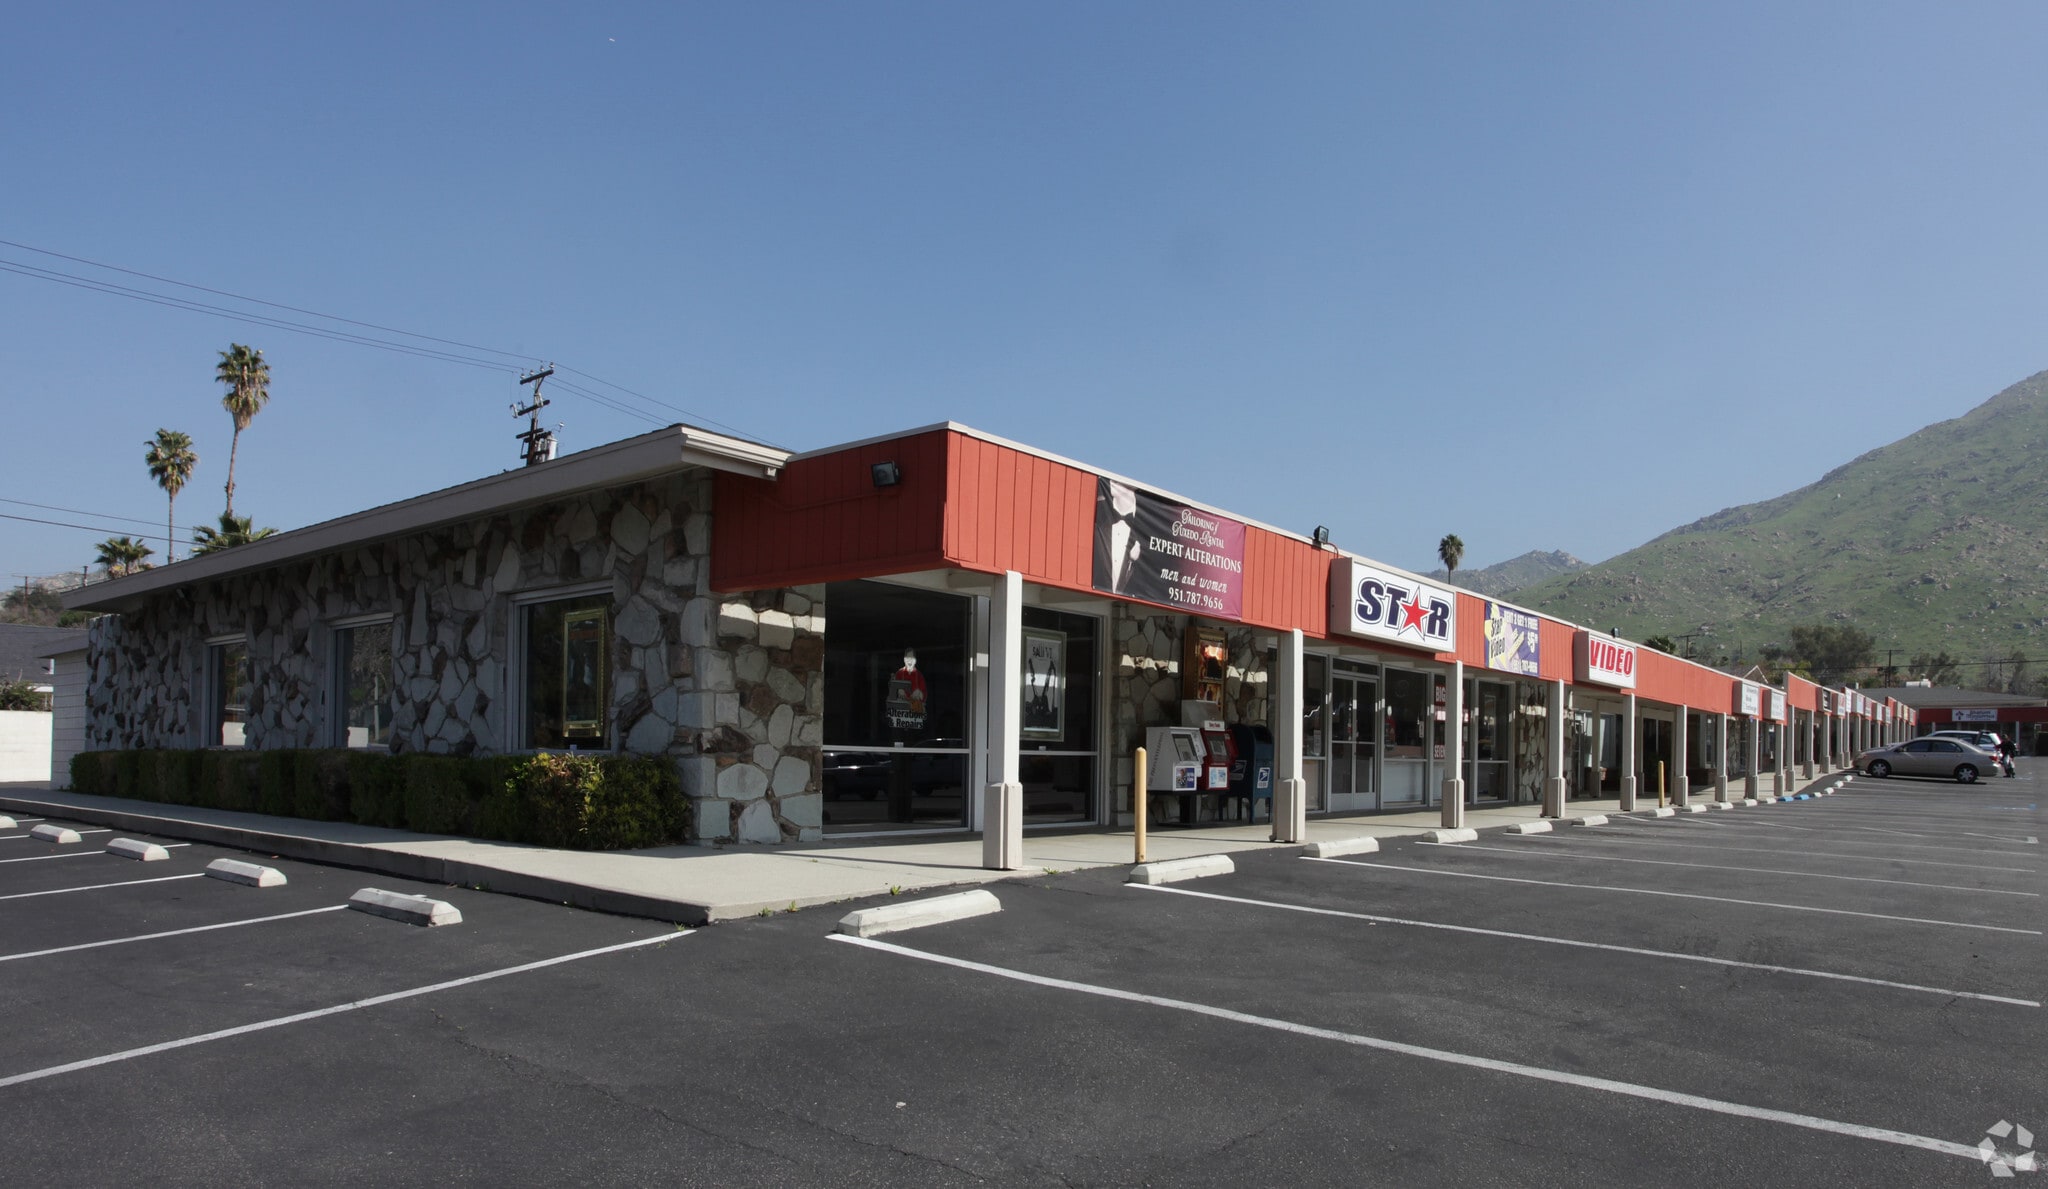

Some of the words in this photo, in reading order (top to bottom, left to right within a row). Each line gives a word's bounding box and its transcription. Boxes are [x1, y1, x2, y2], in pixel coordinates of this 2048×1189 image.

[1172, 521, 1199, 540] TUXEDO
[1199, 531, 1225, 549] RENTAL
[1149, 536, 1184, 558] EXPERT
[1184, 547, 1242, 574] ALTERATIONS
[1160, 568, 1179, 582] men
[1181, 573, 1198, 586] and
[1199, 577, 1228, 593] women
[1168, 586, 1223, 610] 951.787.9656
[1590, 639, 1633, 677] VIDEO
[887, 707, 927, 720] Alterations
[896, 718, 923, 729] Repairs
